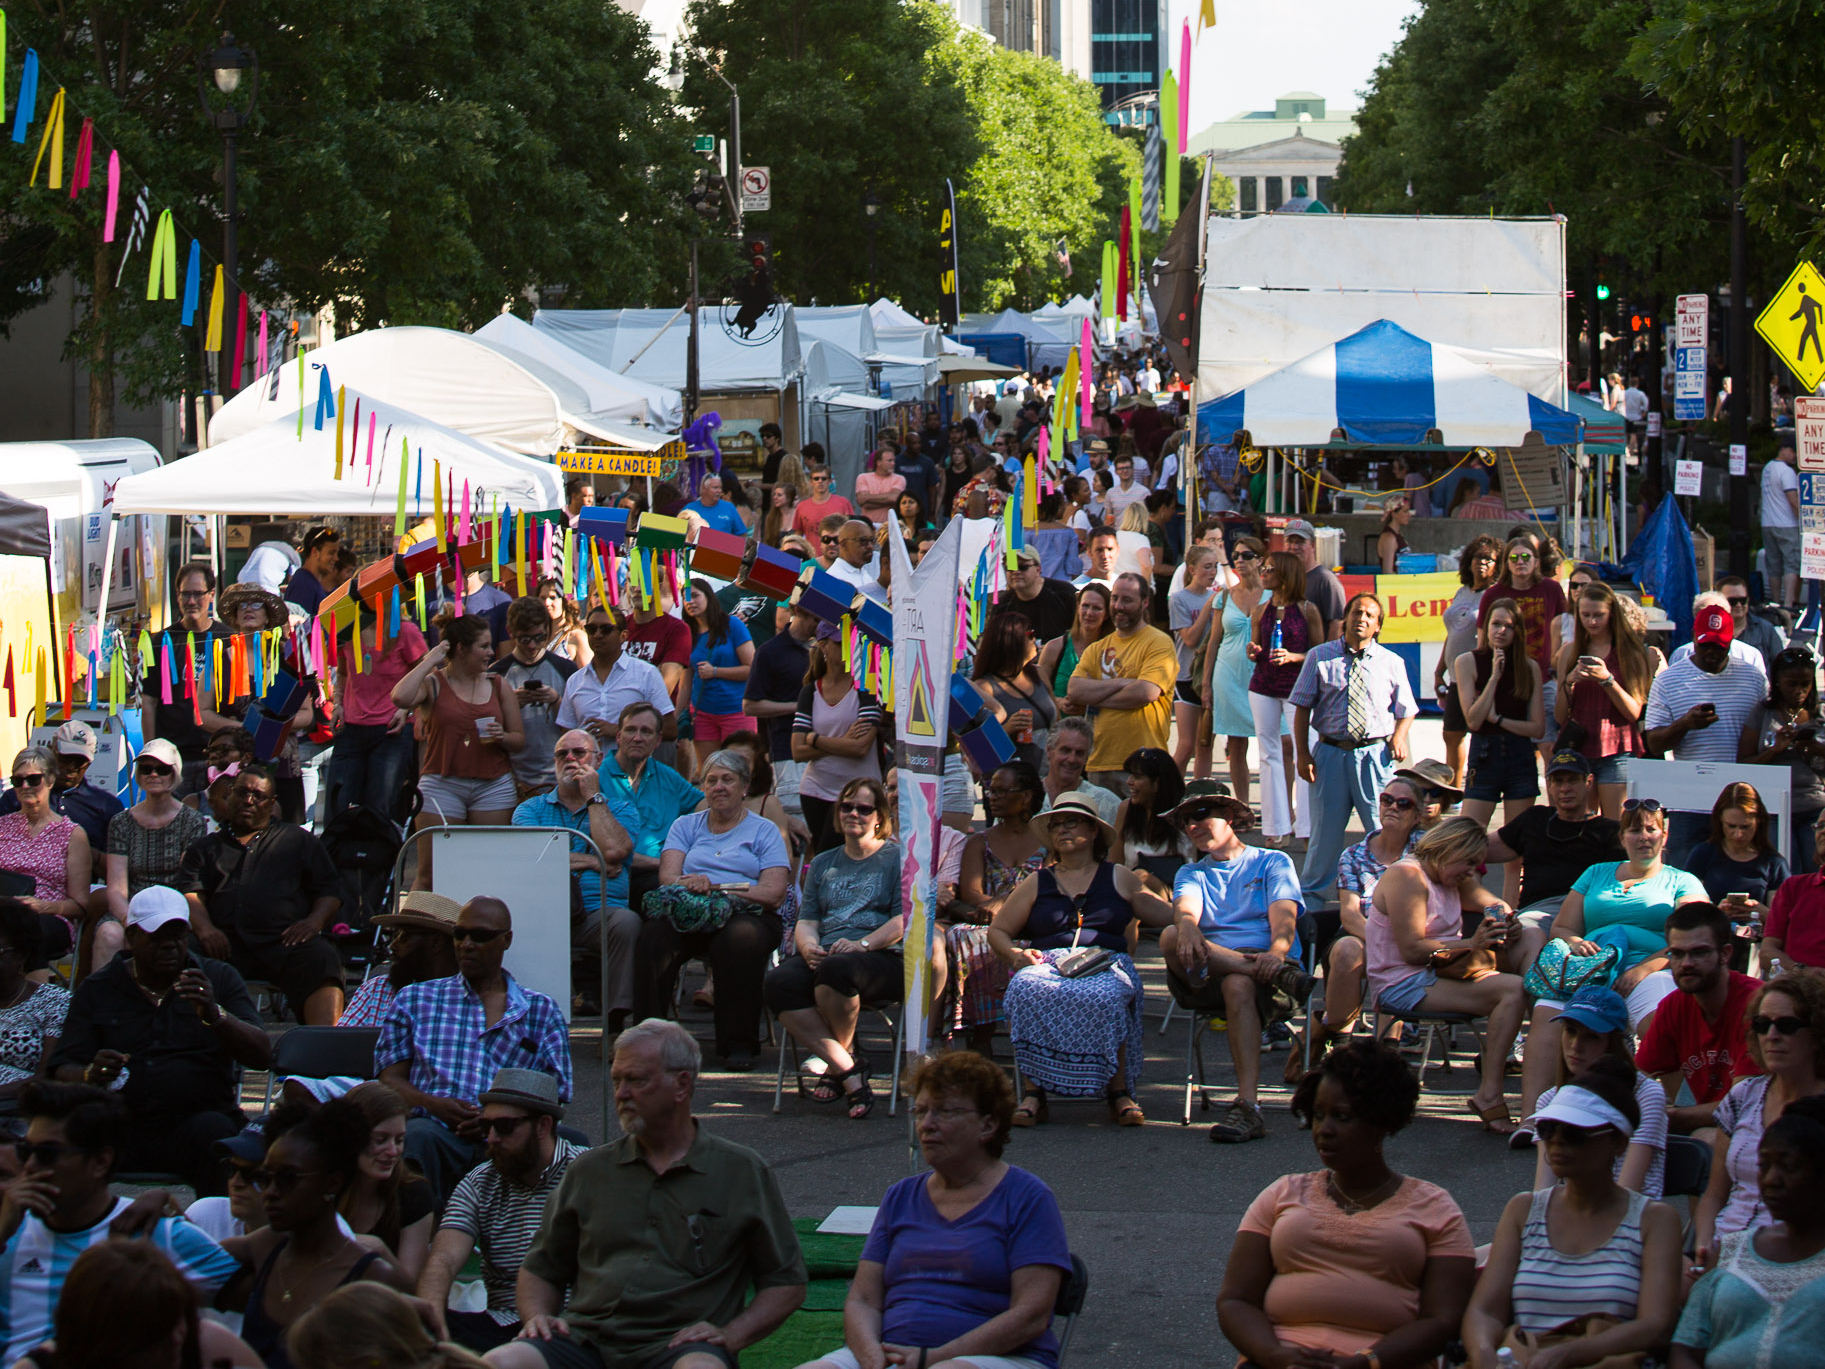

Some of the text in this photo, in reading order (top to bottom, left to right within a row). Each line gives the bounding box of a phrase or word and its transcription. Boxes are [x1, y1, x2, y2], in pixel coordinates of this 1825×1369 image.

[1682, 314, 1701, 325] ANY
[1681, 326, 1702, 337] TIME
[1678, 352, 1685, 369] 2
[1804, 424, 1823, 438] ANY
[1804, 441, 1825, 455] TIME
[560, 456, 656, 473] MAKE A CANDLE!
[1677, 470, 1699, 479] PARKING
[1802, 479, 1810, 500] 2
[1813, 536, 1821, 545] NO
